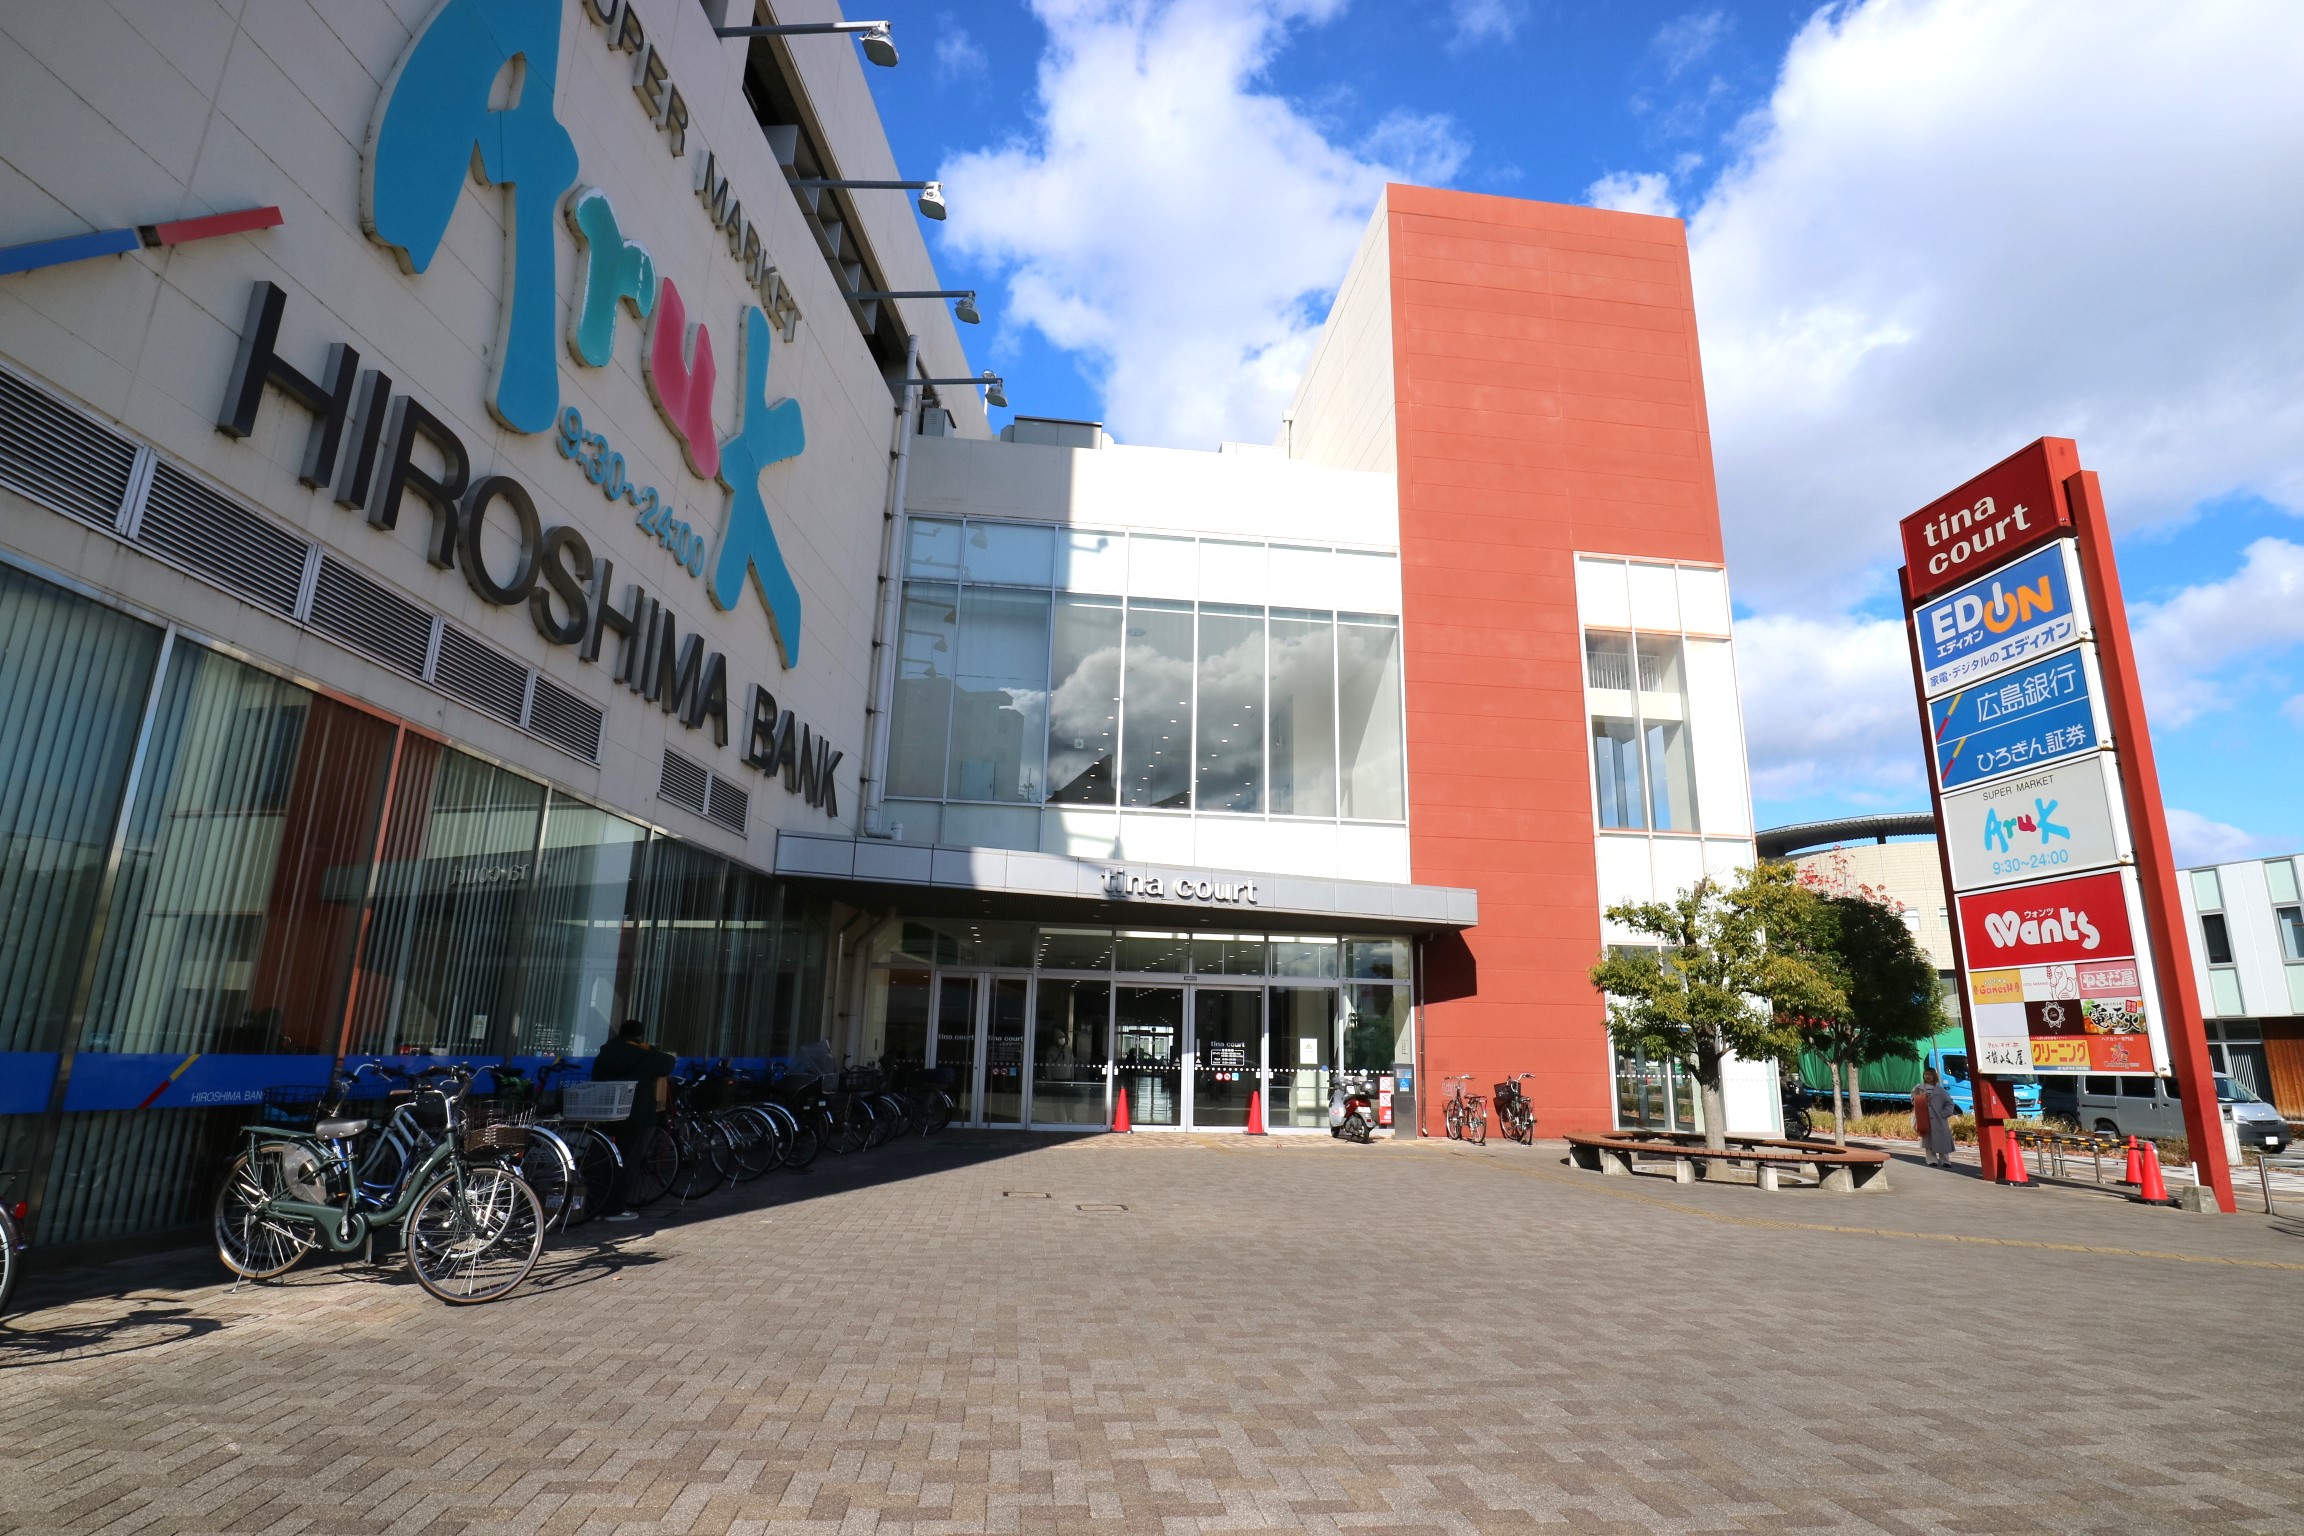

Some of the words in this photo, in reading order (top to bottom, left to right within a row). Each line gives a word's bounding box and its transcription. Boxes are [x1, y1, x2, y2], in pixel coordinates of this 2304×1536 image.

[694, 150, 801, 343] MARKET
[1923, 496, 1996, 547] tina
[1928, 503, 2031, 575] court
[217, 281, 729, 747] HIROSHIMA
[743, 682, 843, 818] BANK
[1931, 575, 2054, 644] EDION
[1937, 629, 1984, 659] エディオン
[1976, 663, 2076, 723] 広島銀行
[1976, 724, 2087, 772] ひろぎん証券
[1983, 786, 2012, 801] SUPER
[2016, 775, 2054, 793] MARKET
[1101, 867, 1165, 896] tina
[1175, 879, 1258, 904] court
[1984, 907, 2100, 950] Wants
[2024, 907, 2054, 919] ウォンツ
[2083, 969, 2136, 988] やまだ屋
[2032, 1042, 2086, 1063] クリーニング
[191, 1091, 242, 1102] HIROSHIMA
[244, 1090, 266, 1101] BAN
